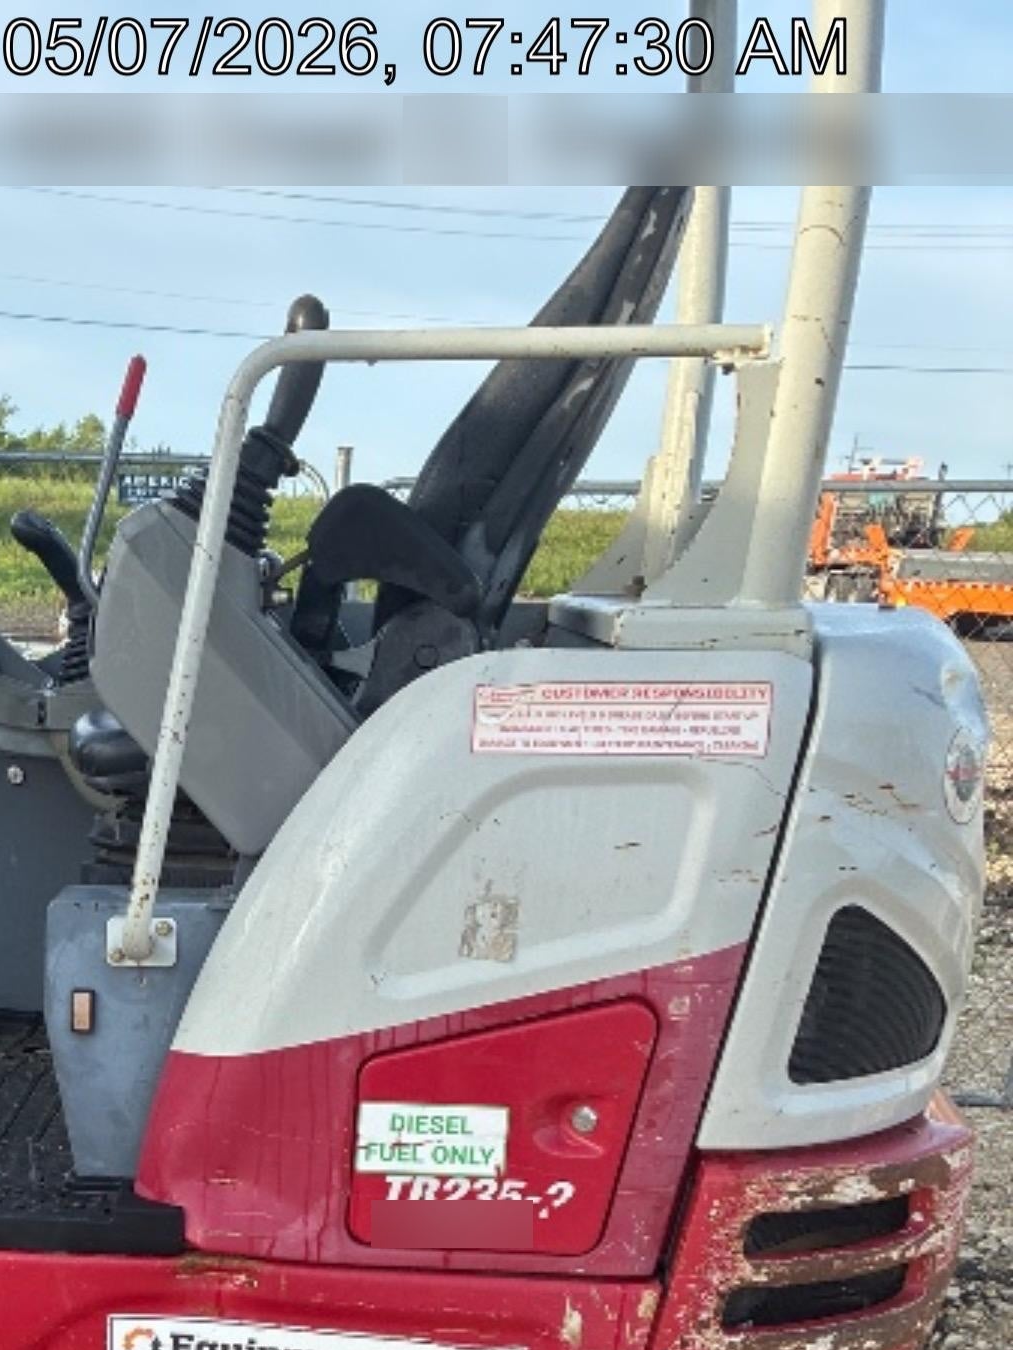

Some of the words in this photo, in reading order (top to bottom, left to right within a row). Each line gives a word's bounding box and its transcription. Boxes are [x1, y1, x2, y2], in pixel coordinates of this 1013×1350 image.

[389, 1113, 473, 1135] DIESEL
[364, 1142, 425, 1163] FUEL
[431, 1146, 495, 1165] ONLY
